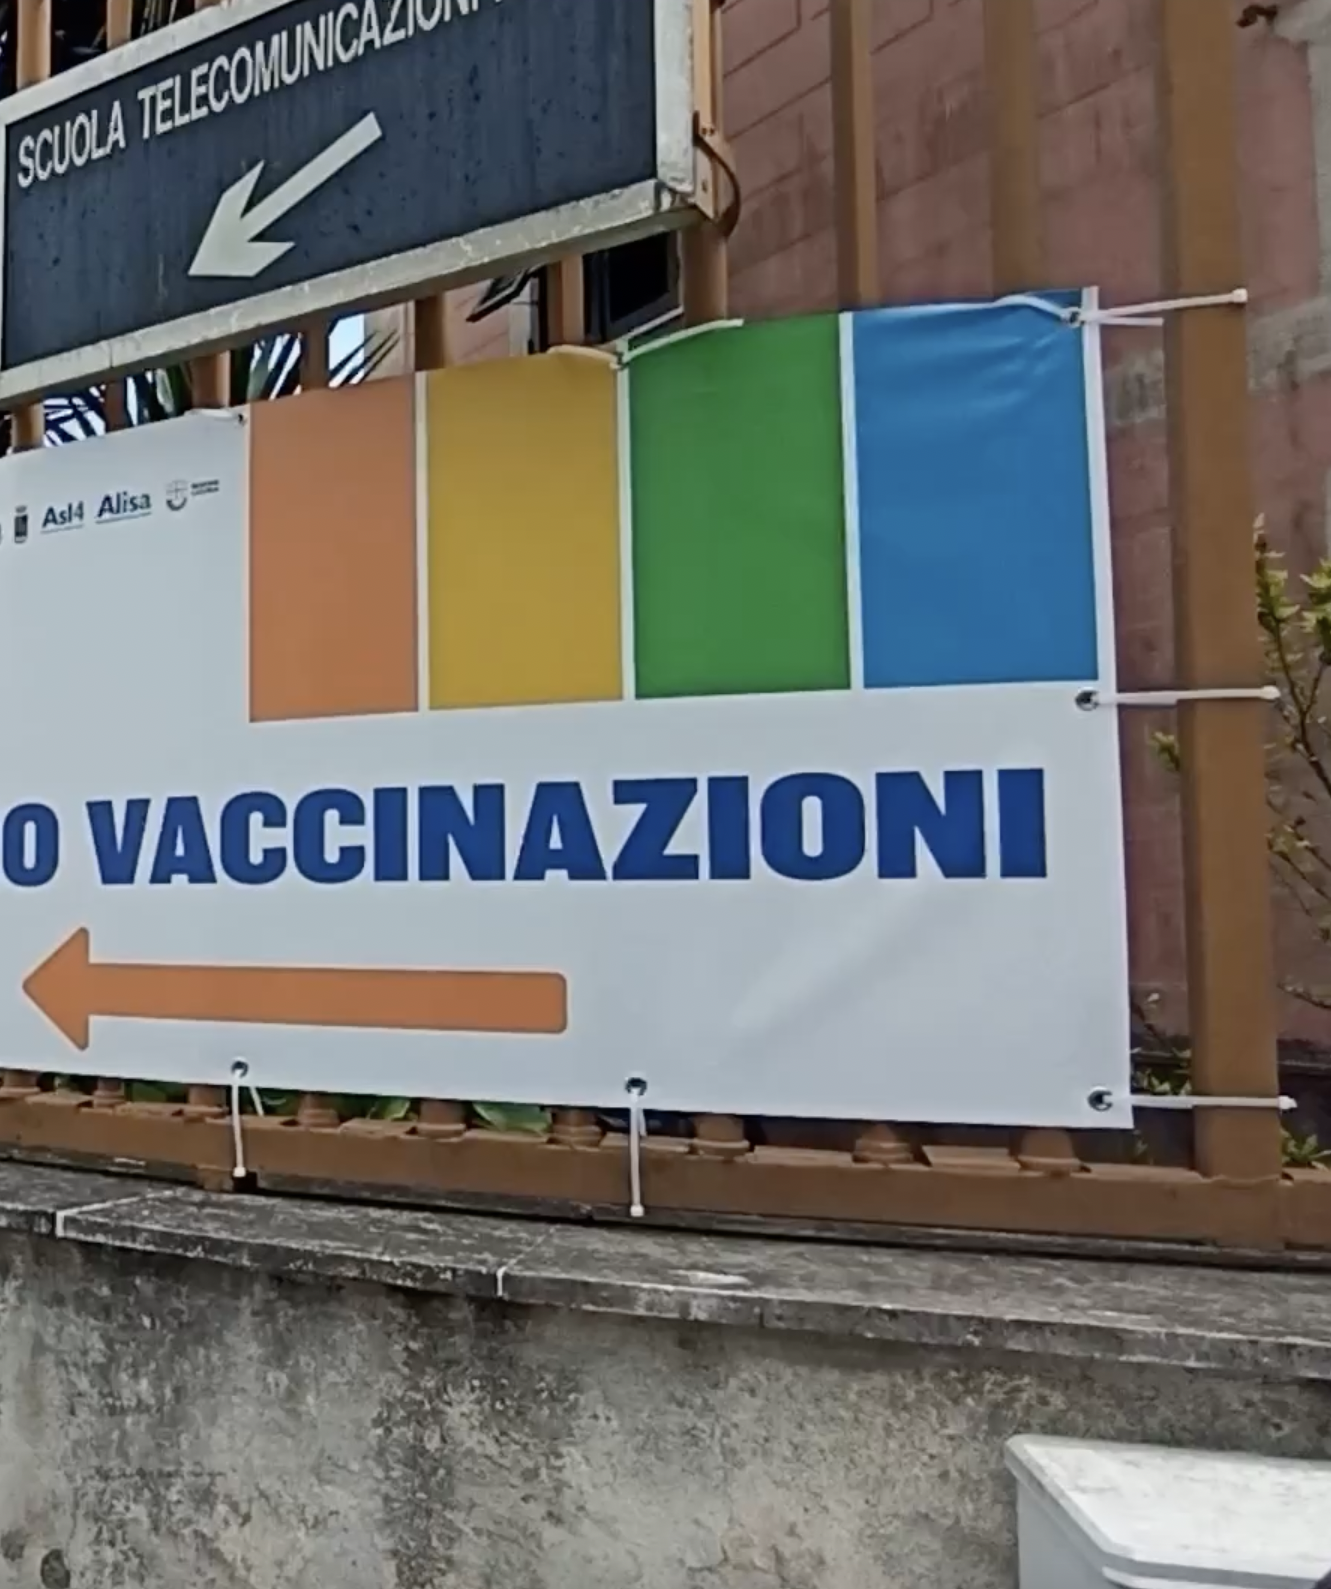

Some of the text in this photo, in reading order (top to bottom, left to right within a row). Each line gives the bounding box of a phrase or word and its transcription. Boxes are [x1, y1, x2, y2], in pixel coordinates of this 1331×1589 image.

[17, 0, 479, 188] SCUOLA TELECOMUNICAZIO
[41, 491, 152, 528] Asl4 Alisa
[86, 767, 1048, 886] VACCINAZIONI
